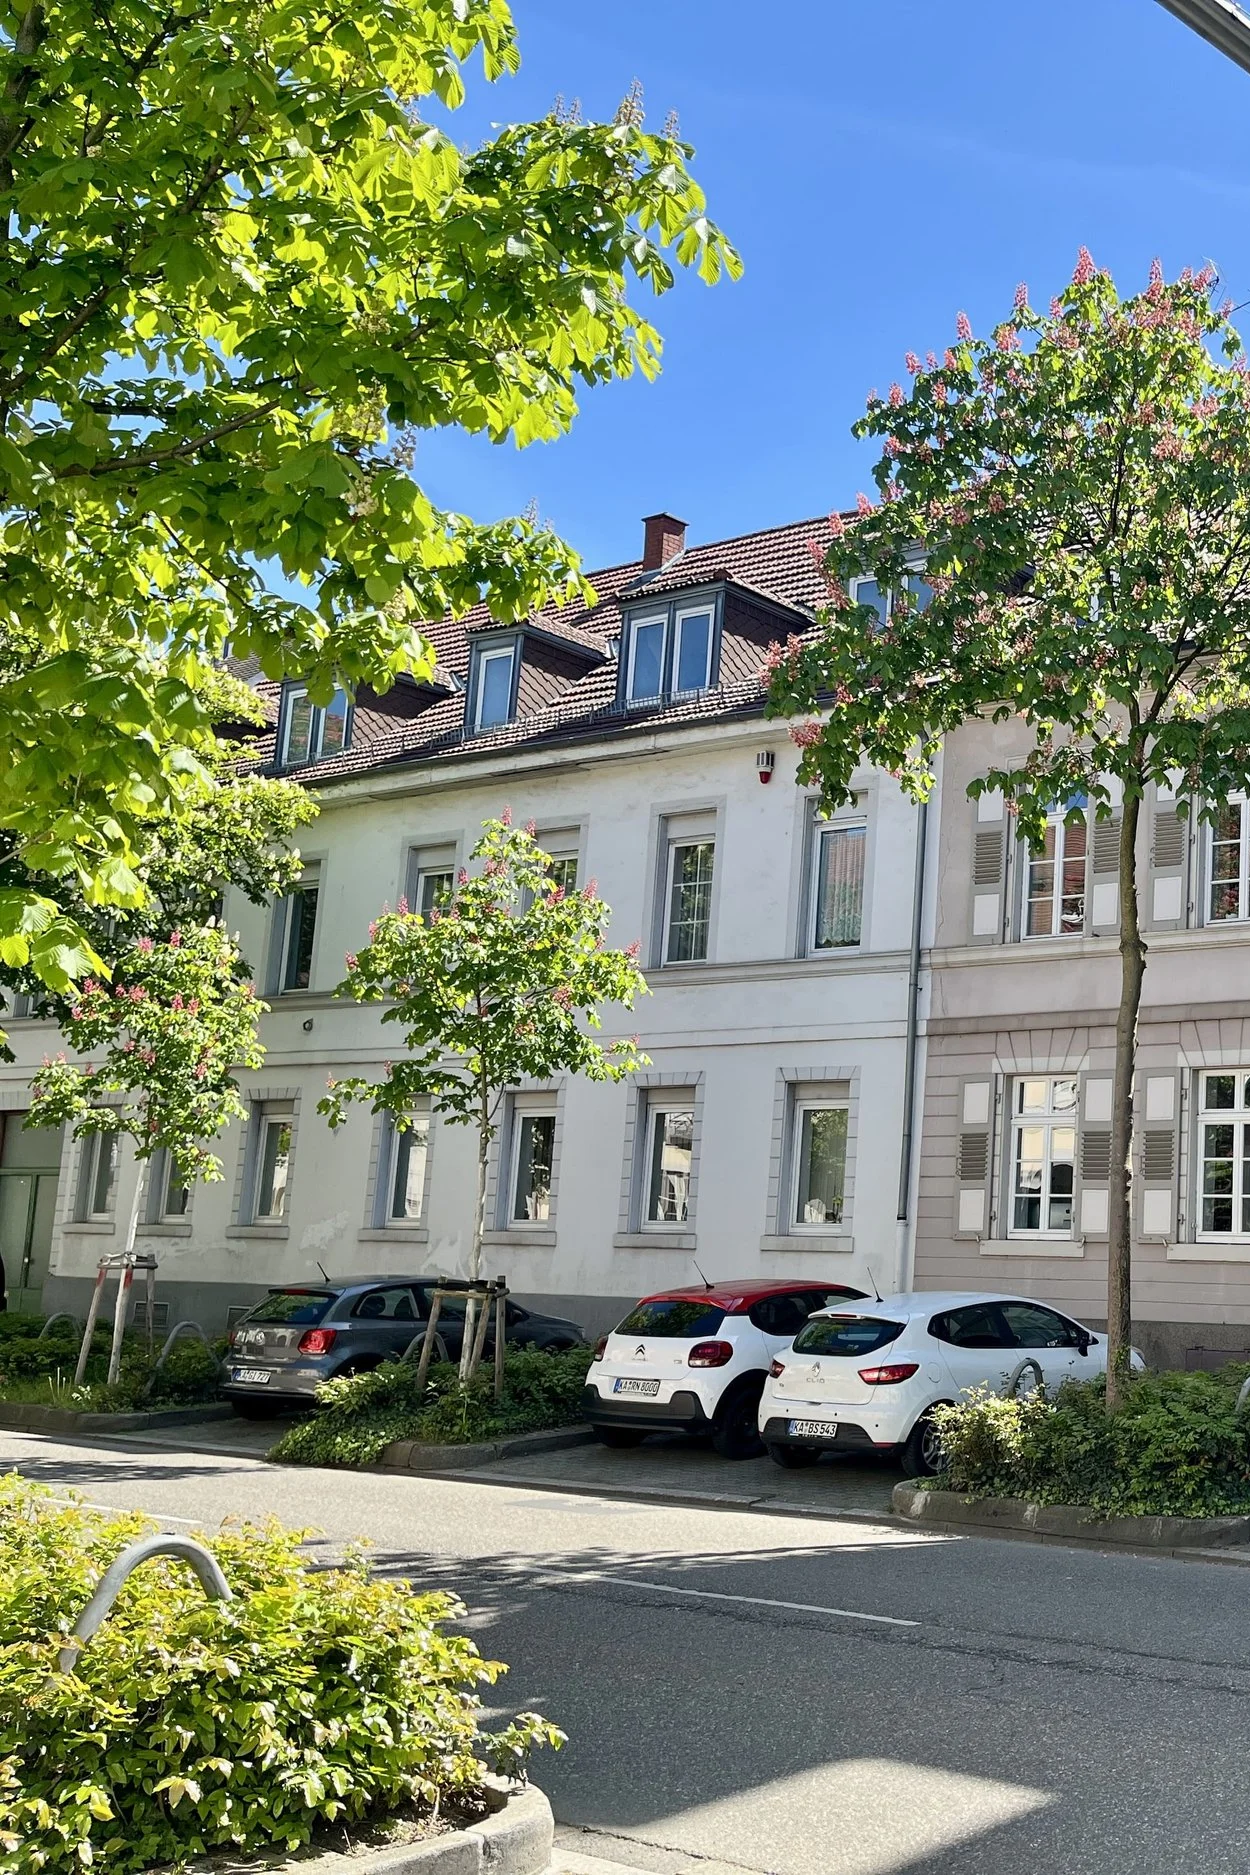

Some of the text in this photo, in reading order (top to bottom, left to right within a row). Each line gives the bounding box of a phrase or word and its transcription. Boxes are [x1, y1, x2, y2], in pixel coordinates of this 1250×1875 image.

[794, 1421, 804, 1432] KA
[808, 1422, 820, 1434] BS
[820, 1424, 836, 1436] 543
